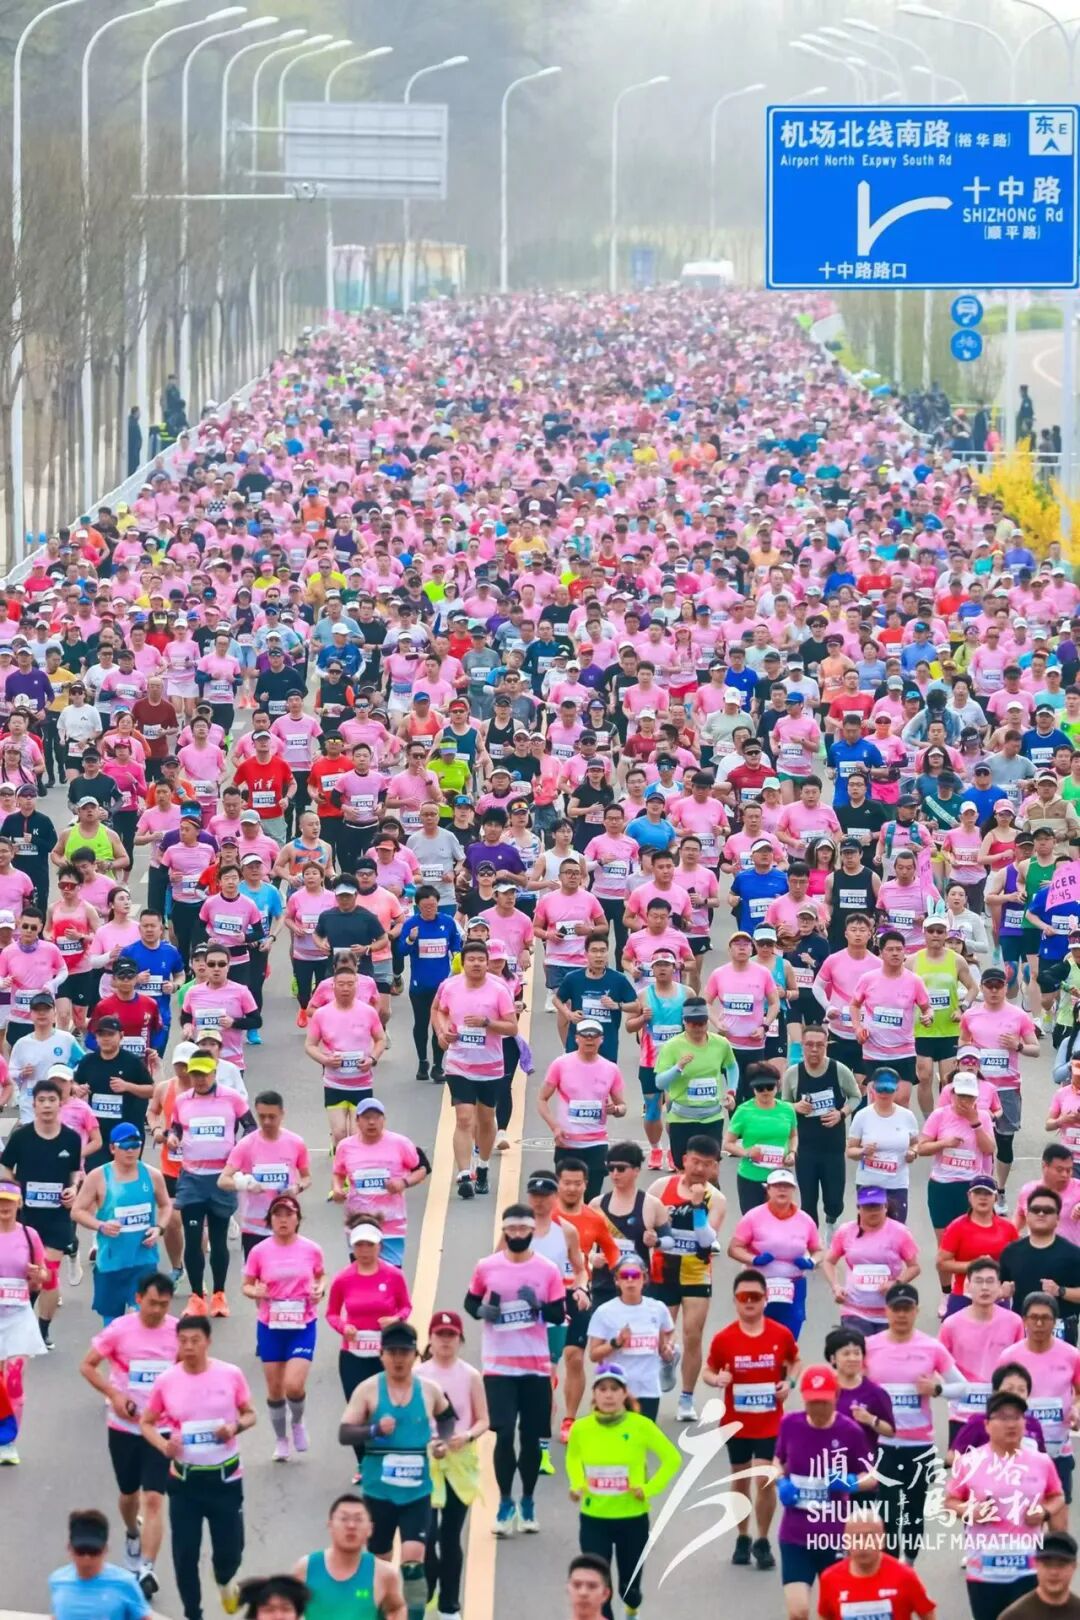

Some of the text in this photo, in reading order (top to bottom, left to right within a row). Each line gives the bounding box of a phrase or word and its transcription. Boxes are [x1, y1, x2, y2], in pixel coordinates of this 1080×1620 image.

[780, 119, 951, 148] 机场北线南路
[1035, 115, 1068, 135] 东 E
[780, 154, 952, 168] Airport North Expwy South Rd
[962, 175, 1062, 205] 十中路
[962, 207, 1064, 223] SHIZHONG Rd
[818, 261, 908, 280] 十中路路口
